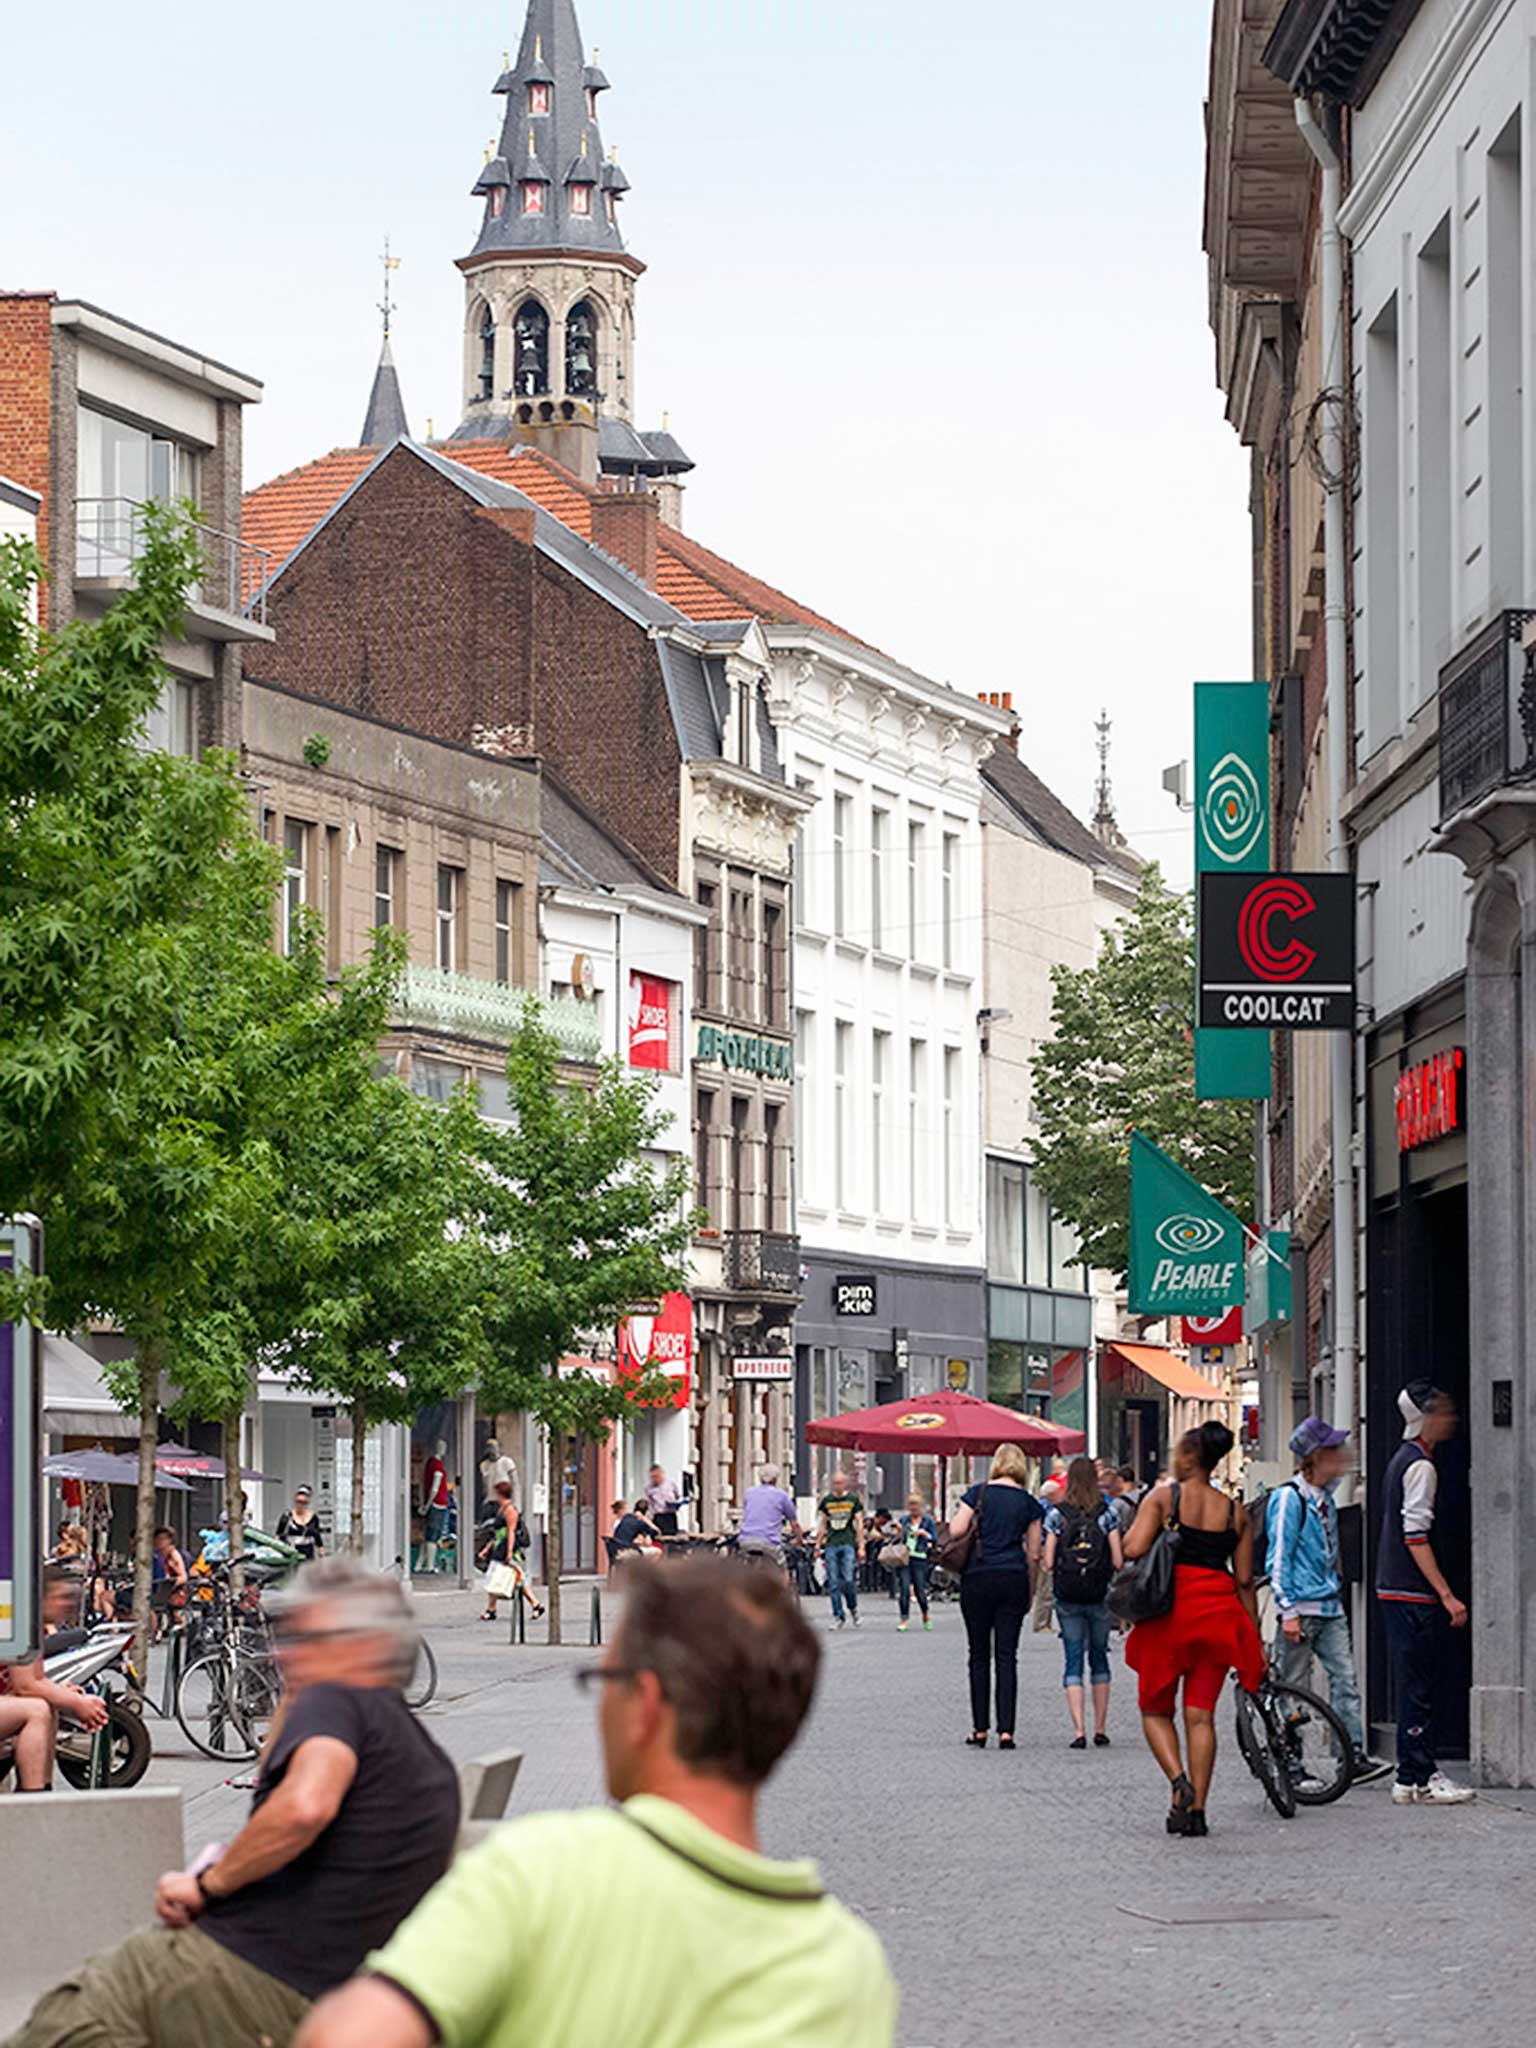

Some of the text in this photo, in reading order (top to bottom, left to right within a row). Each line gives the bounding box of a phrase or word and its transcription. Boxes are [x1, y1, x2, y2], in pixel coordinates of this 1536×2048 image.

[1237, 878, 1316, 982] C
[1223, 994, 1325, 1021] COOLCAT
[1151, 1259, 1237, 1292] PEARLE
[653, 1331, 687, 1358] SHOES
